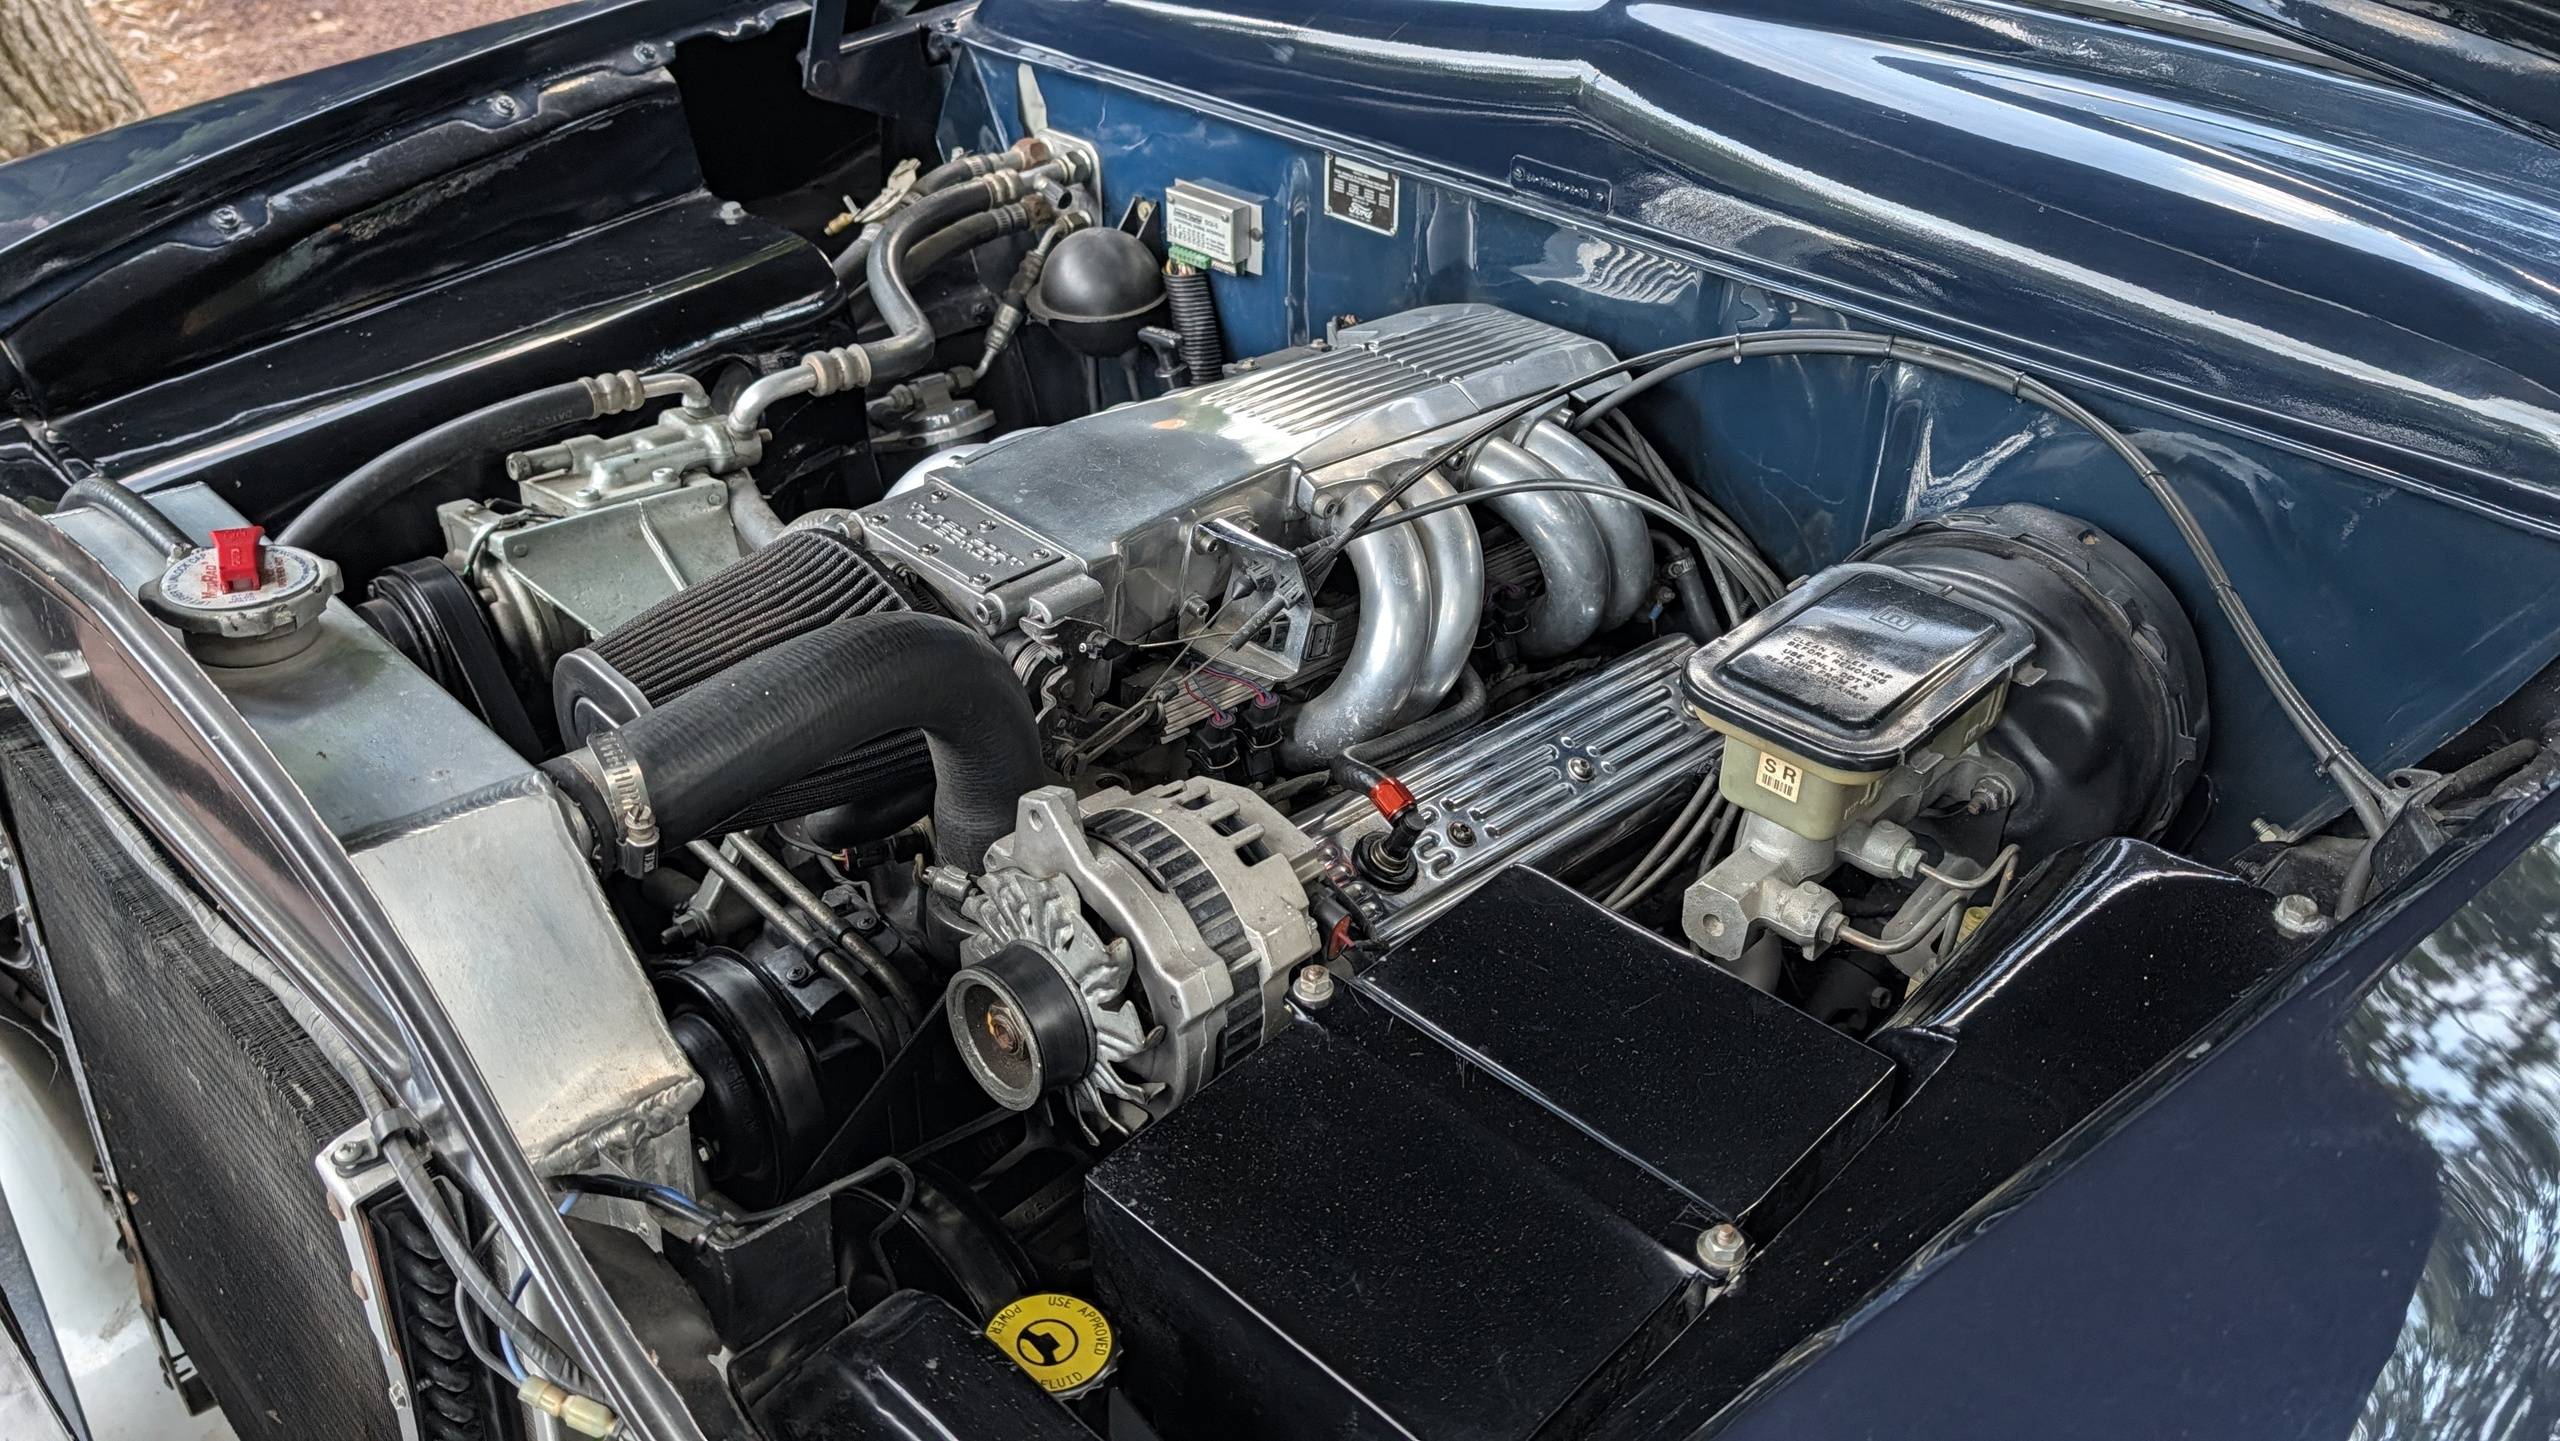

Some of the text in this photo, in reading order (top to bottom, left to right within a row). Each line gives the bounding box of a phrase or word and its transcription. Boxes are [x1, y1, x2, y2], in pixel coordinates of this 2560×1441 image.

[1348, 202, 1374, 220] Ford
[1783, 648, 1805, 660] USE
[1808, 659, 1836, 673] ONLY
[1839, 672, 1863, 684] DOT
[1783, 655, 1814, 671] FLUID
[1817, 670, 1849, 685] FROM
[1786, 641, 1888, 685] BEFORE REMOVING
[1793, 636, 1893, 680] CLEAN FILLER CAP
[1809, 674, 1869, 702] CONTAINER
[989, 1304, 1022, 1335] POWER
[1048, 1296, 1109, 1356] USE APPROVED
[1040, 1371, 1083, 1390] FLUID
